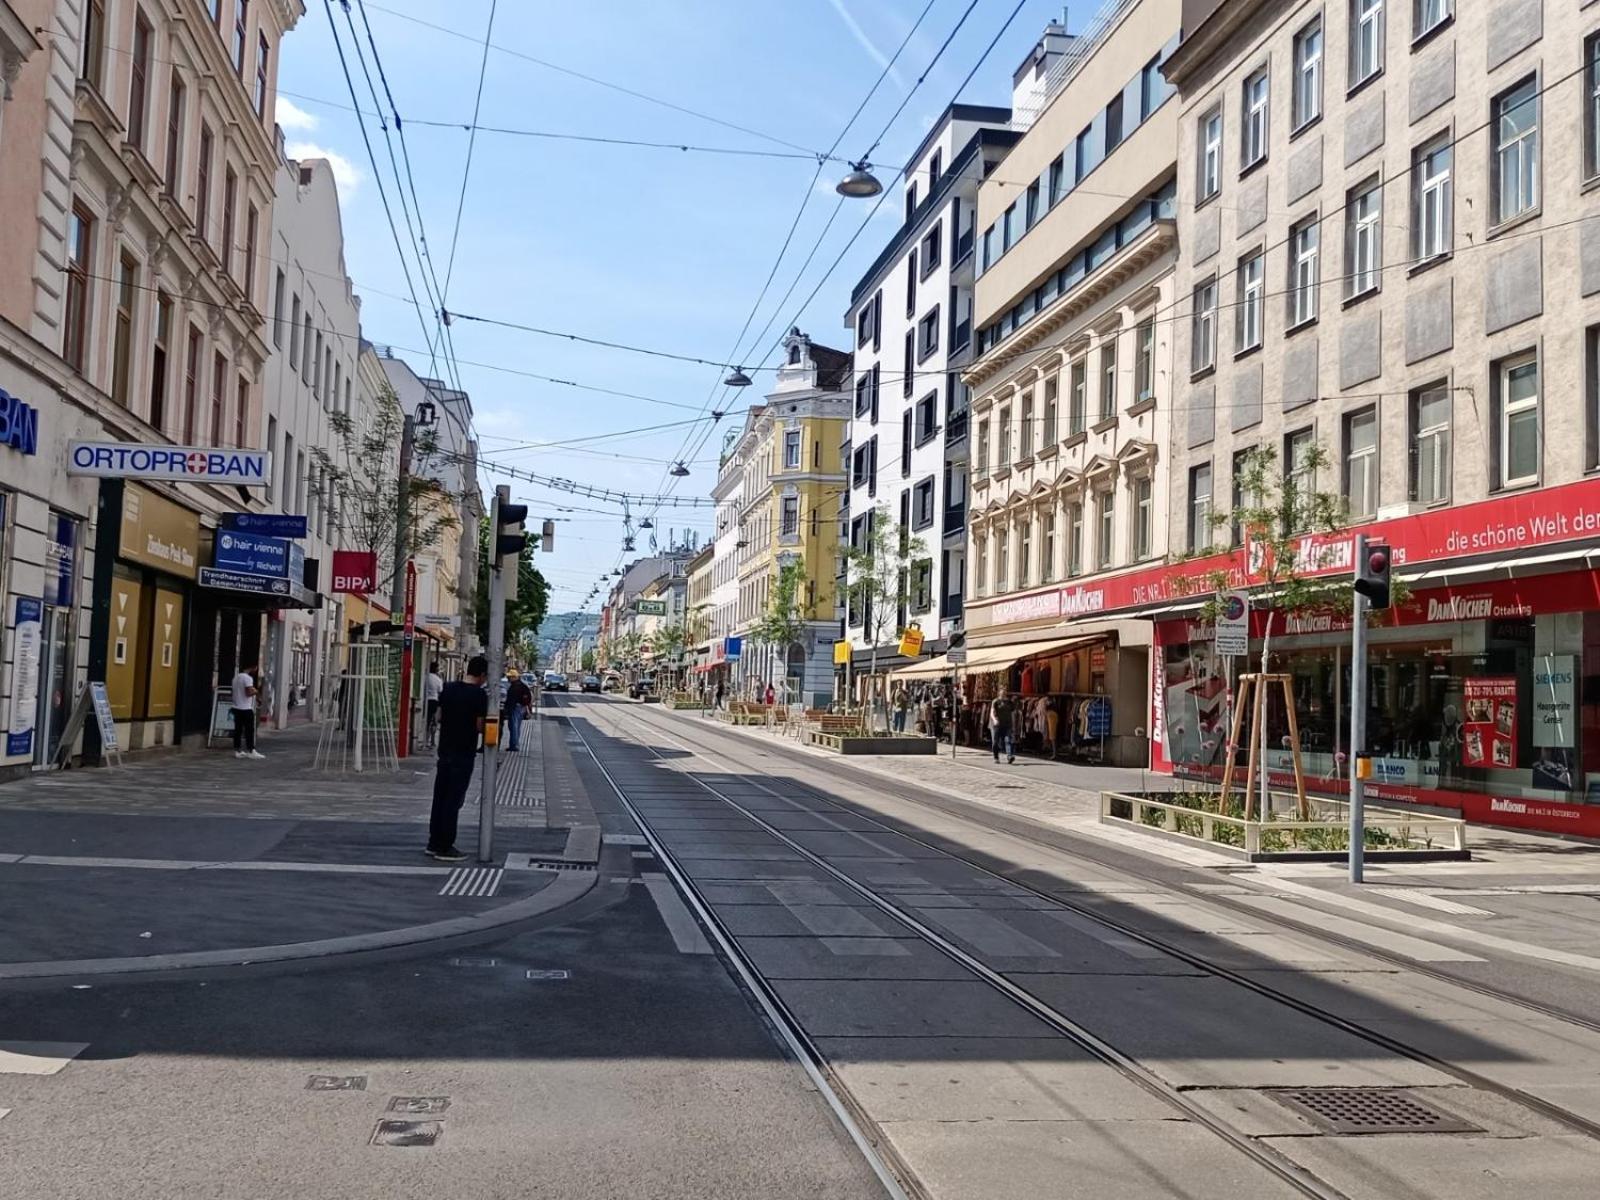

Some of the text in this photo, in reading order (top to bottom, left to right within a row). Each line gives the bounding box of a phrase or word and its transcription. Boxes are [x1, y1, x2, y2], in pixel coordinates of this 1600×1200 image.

[1446, 531, 1468, 551] die
[1472, 523, 1526, 548] schöne
[1529, 511, 1568, 539] Welt
[233, 539, 252, 551] hair
[334, 576, 371, 589] BIPA
[1133, 586, 1147, 604] DIE
[1427, 596, 1532, 621] DANKÜCHEN Ottakring
[1536, 673, 1572, 685] SIEMENS
[1424, 765, 1440, 776] LAN
